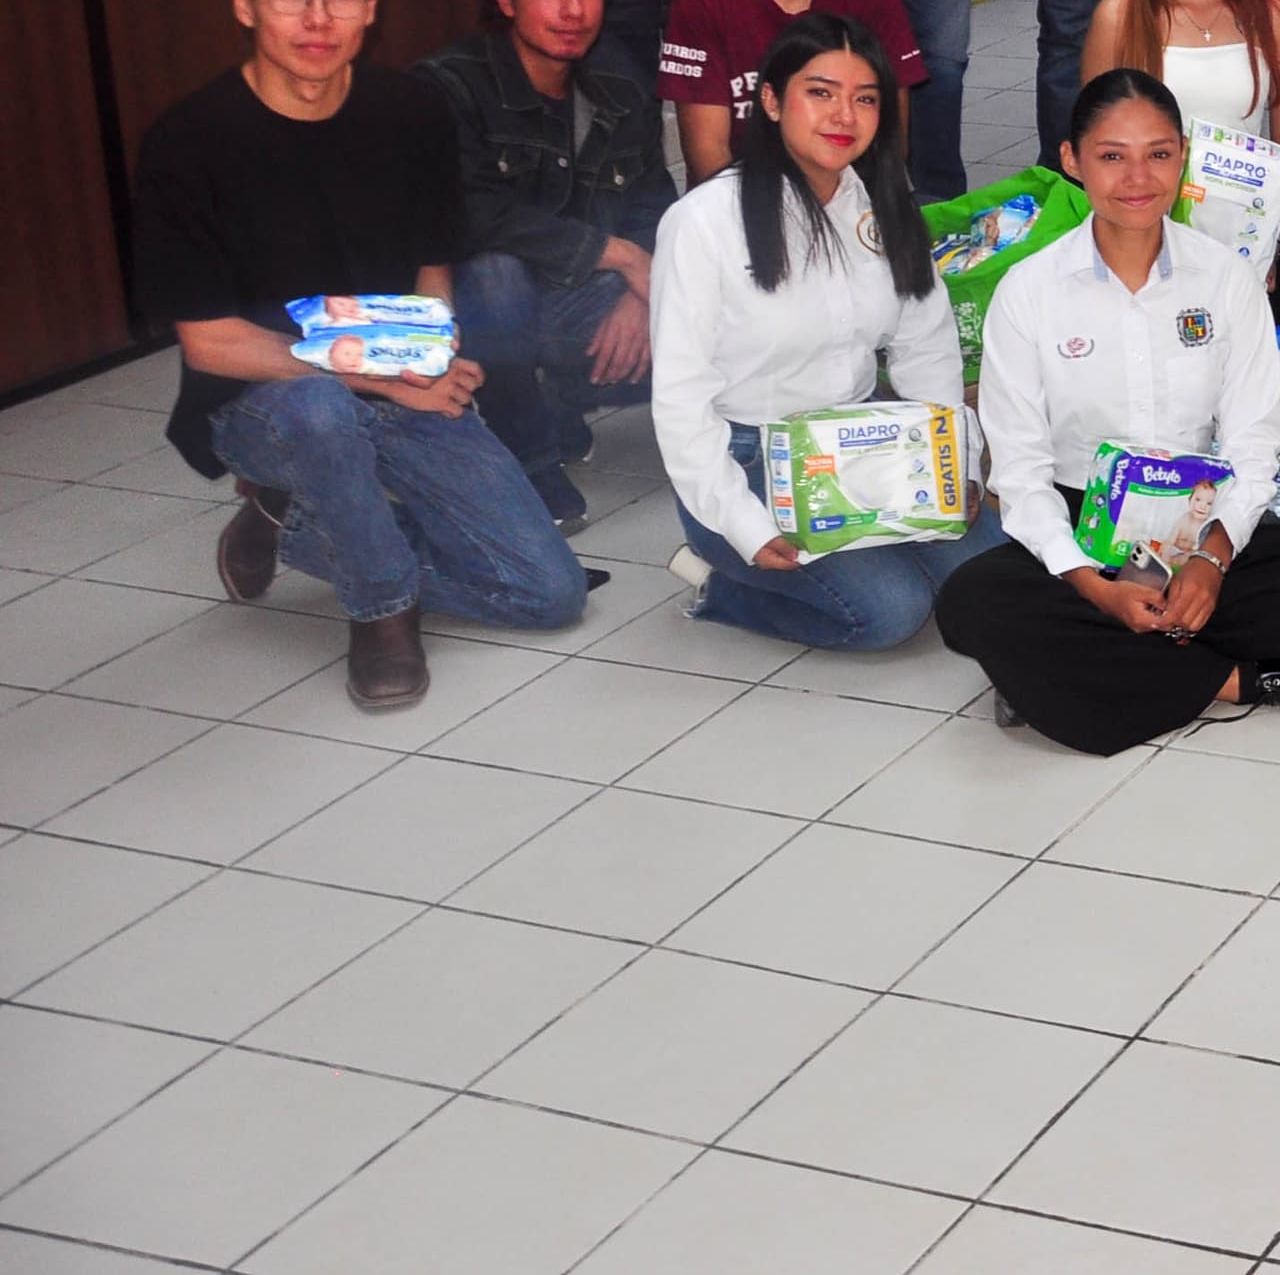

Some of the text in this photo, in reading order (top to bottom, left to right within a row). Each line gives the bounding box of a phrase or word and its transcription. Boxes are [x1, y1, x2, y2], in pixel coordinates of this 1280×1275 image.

[659, 60, 703, 78] ARDOS
[1203, 151, 1267, 180] DIAPRO
[837, 423, 901, 441] DIAPRO
[940, 443, 957, 508] GRATIS
[1141, 464, 1182, 486] Bebyto
